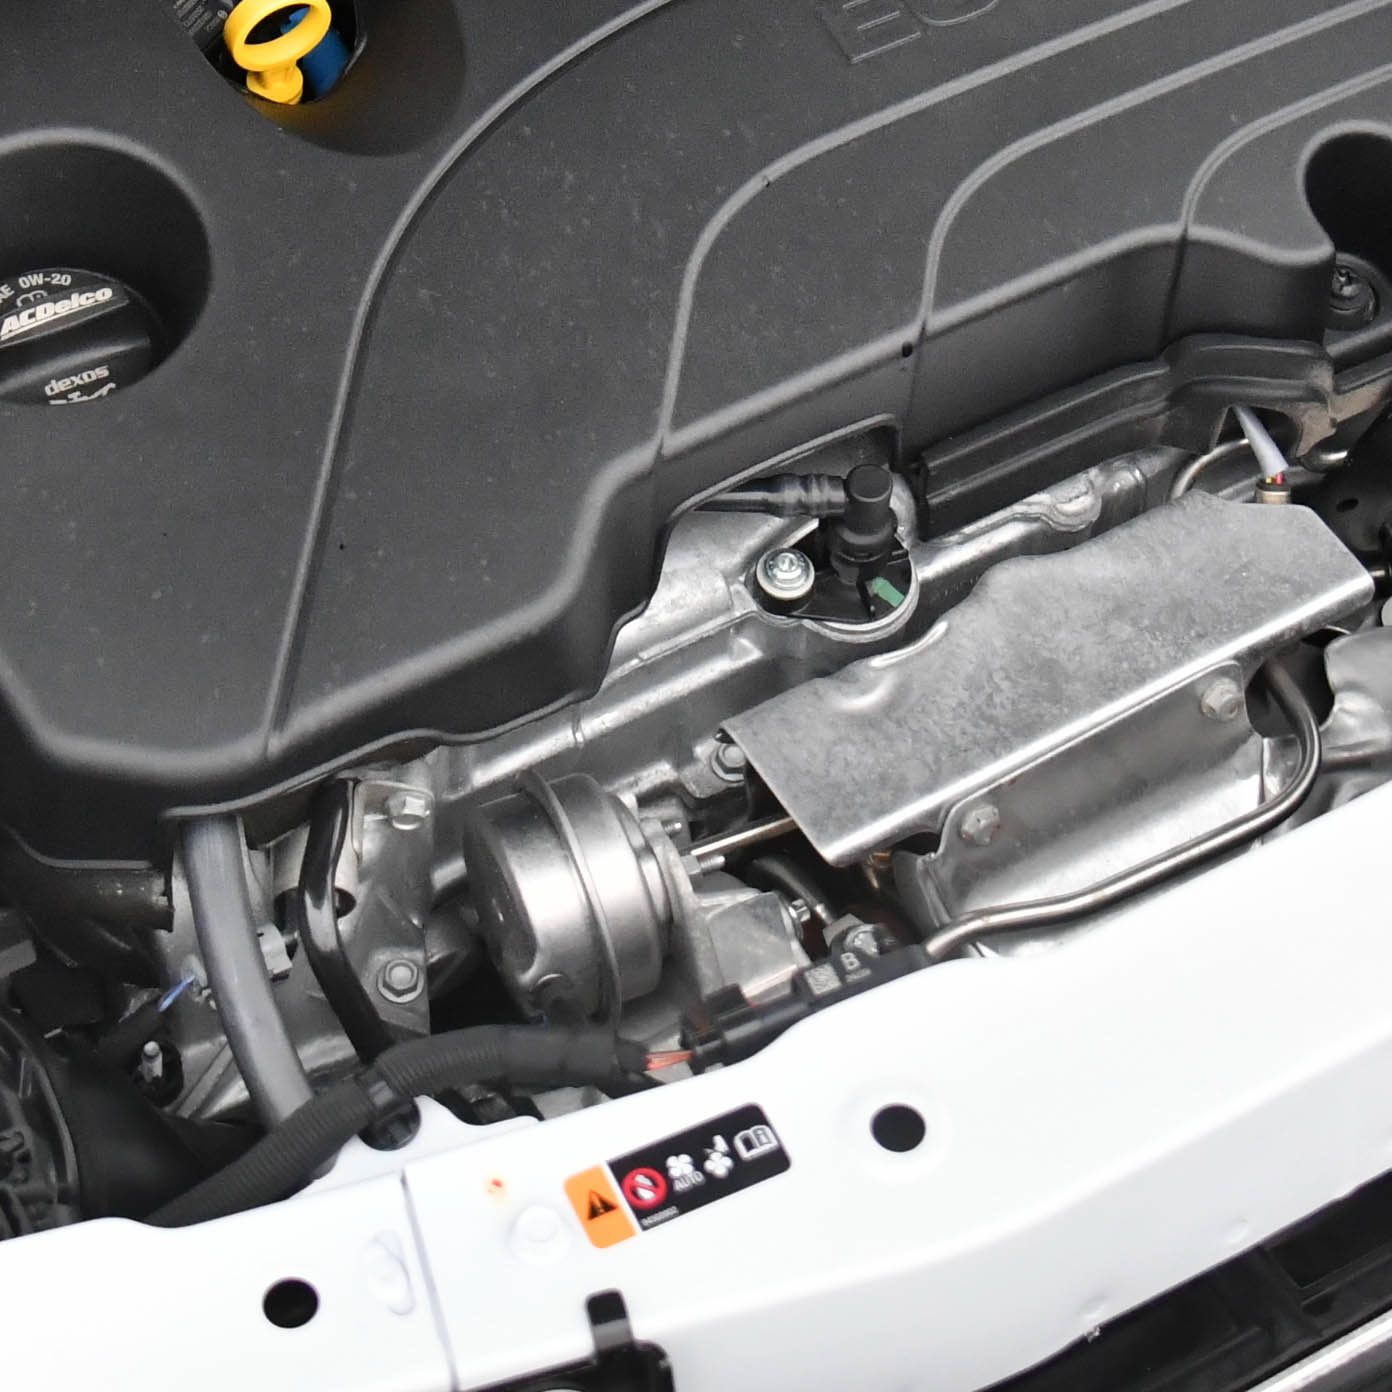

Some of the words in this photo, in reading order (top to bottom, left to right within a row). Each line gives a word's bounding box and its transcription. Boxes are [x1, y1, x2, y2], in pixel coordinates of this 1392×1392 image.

[18, 273, 72, 289] 0W-20
[0, 287, 114, 338] ACDelco
[44, 364, 111, 397] dexos
[673, 1171, 705, 1192] AUTO
